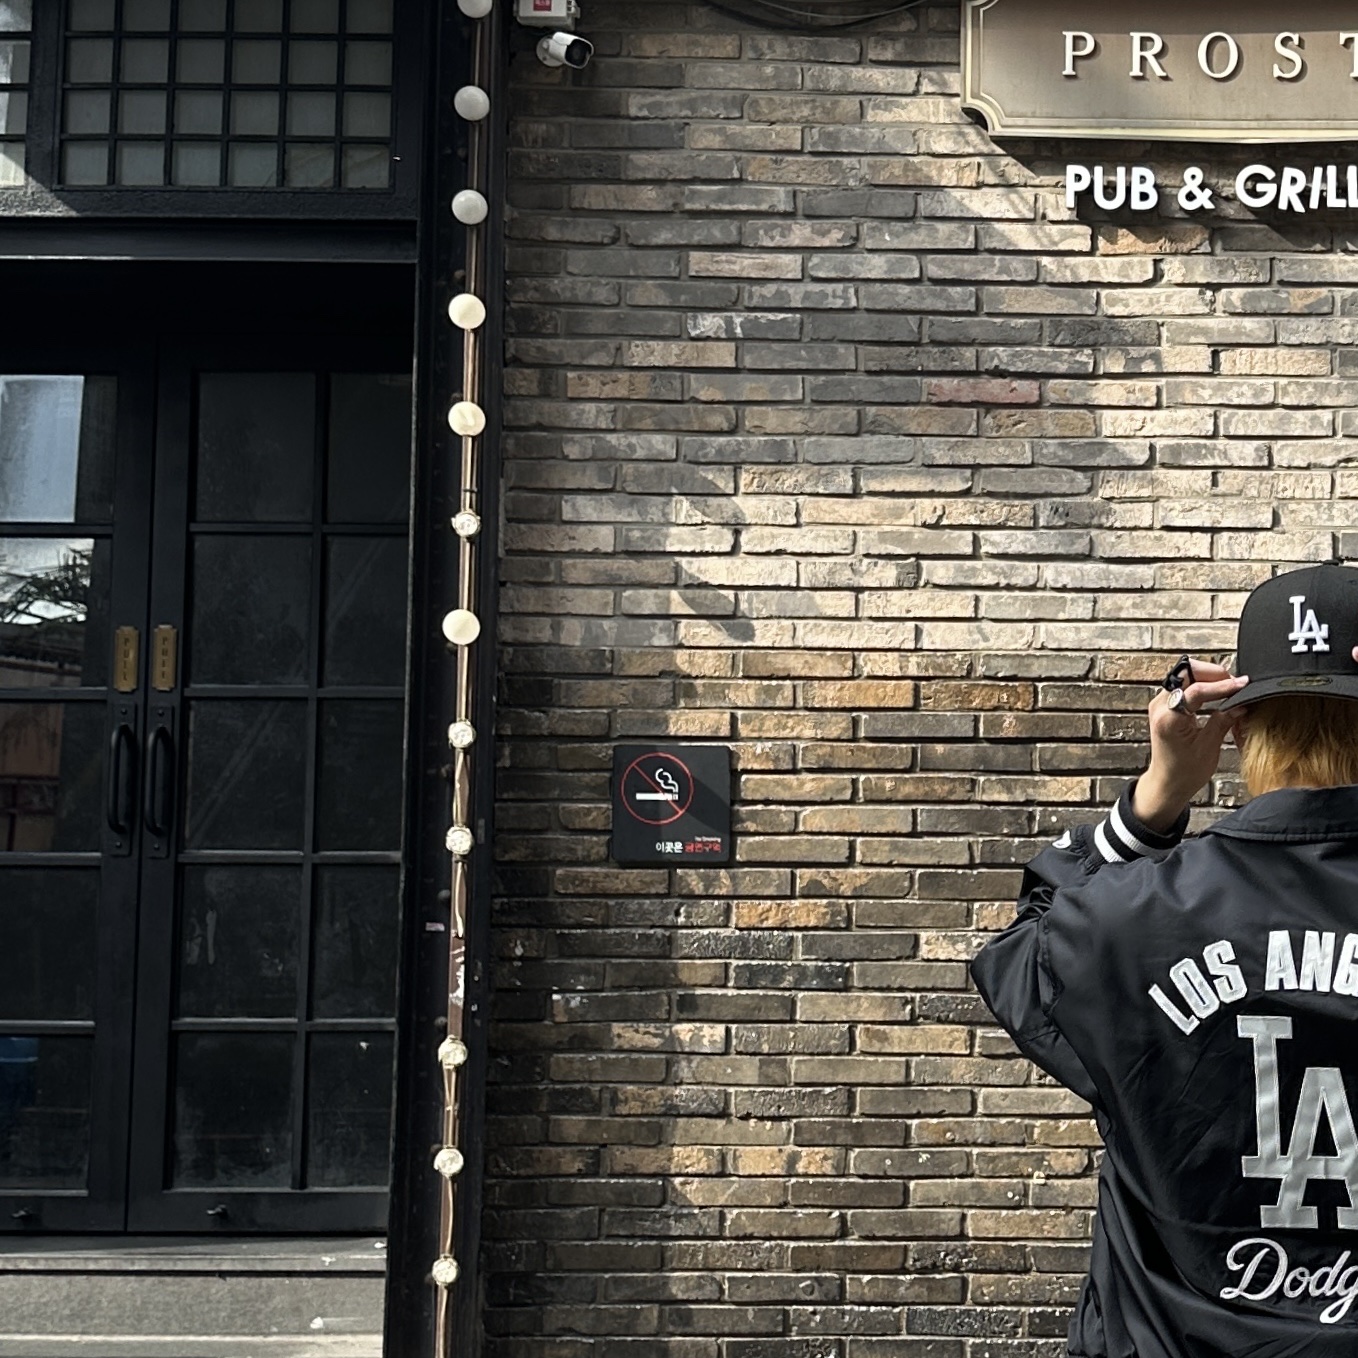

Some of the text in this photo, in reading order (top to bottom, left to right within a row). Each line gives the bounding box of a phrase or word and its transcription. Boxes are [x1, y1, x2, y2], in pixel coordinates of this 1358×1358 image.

[1065, 163, 1158, 211] PUB
[1177, 165, 1216, 211] &
[1288, 595, 1330, 653] LA
[1148, 939, 1248, 1036] LOS
